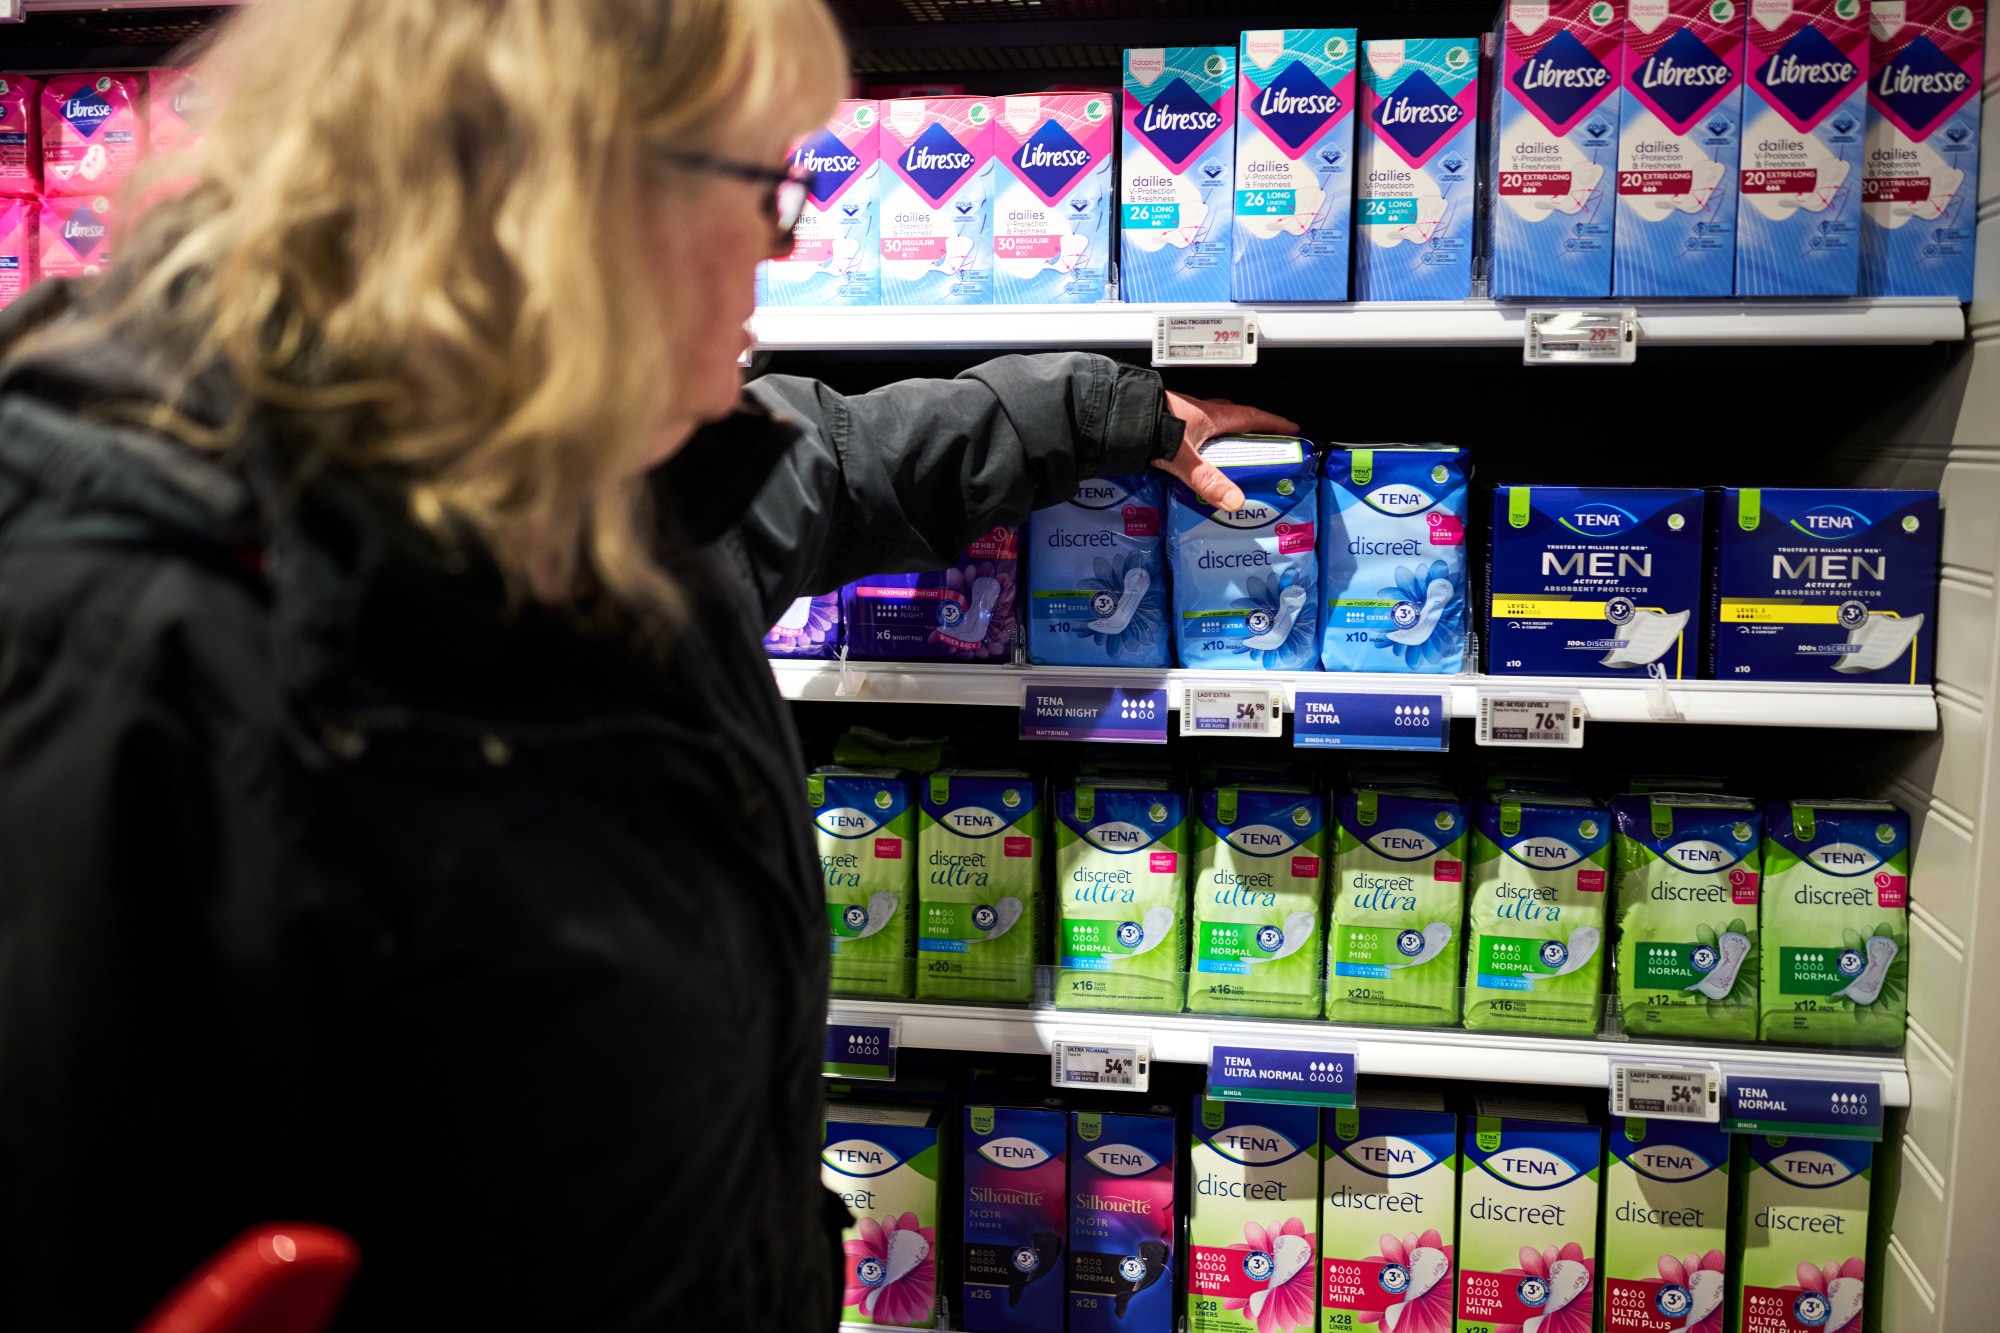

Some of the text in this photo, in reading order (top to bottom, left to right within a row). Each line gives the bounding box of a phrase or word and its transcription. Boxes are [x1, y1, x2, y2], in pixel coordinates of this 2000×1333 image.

[1523, 58, 1606, 89] Libresse
[1642, 56, 1727, 89] Libresse
[1765, 54, 1853, 86] Libresse
[1879, 65, 1967, 97] Libresse
[1260, 87, 1337, 116] Libresse
[66, 100, 110, 119] Libresse
[1381, 97, 1458, 126] Libresse
[1143, 104, 1217, 132] Libresse
[1515, 141, 1559, 154] dailies
[1758, 139, 1804, 152] dailies
[906, 147, 971, 171] Libresse
[1020, 143, 1086, 168] Libresse
[1248, 161, 1290, 172] dailies
[1369, 170, 1411, 182] dailies
[1501, 173, 1522, 188] 20
[1523, 173, 1570, 181] EXTRA LONG
[1745, 171, 1766, 186] 20
[1766, 170, 1816, 178] EXTRA LONG
[1132, 176, 1173, 187] dailies
[1128, 187, 1176, 195] V-Protection
[1137, 194, 1175, 203] Freshness
[1244, 193, 1264, 207] 26
[1130, 206, 1149, 220] 26
[1151, 206, 1174, 214] LONG
[895, 212, 930, 223] dailies
[64, 220, 104, 238] Libresse
[884, 240, 901, 252] 30
[902, 239, 935, 247] REGULAR
[1214, 331, 1229, 342] 29
[1078, 488, 1113, 498] TENA
[1378, 493, 1419, 505] TENA
[1224, 508, 1266, 520] TENA
[1574, 514, 1620, 527] TENA
[1806, 516, 1853, 529] TENA
[1048, 529, 1118, 548] discreet
[1347, 536, 1422, 556] discreet
[1198, 549, 1272, 569] discreet
[1542, 552, 1652, 578] MEN
[1772, 555, 1886, 581] MEN
[909, 590, 939, 598] COMFORT
[1049, 622, 1070, 633] x10
[876, 629, 891, 640] x6
[939, 634, 977, 648] WIDER BACK
[1346, 632, 1368, 643] x10
[1036, 696, 1064, 706] TENA
[1305, 702, 1335, 713] TENA
[1036, 707, 1098, 718] MAXI NIGHT
[1236, 703, 1265, 719] 54 98
[1305, 713, 1341, 725] EXTRA
[1535, 713, 1565, 730] 76 98
[828, 815, 865, 828] TENA
[953, 814, 993, 827] TENA
[1098, 830, 1139, 842] TENA
[1240, 833, 1281, 846] TENA
[1381, 836, 1423, 850] TENA
[929, 850, 986, 867] discreet
[1524, 845, 1566, 859] TENA
[1677, 849, 1720, 862] TENA
[1820, 852, 1864, 864] TENA
[1073, 866, 1132, 884] discreet
[1213, 869, 1274, 888] discreet
[1353, 873, 1414, 892] discreet
[1075, 879, 1135, 904] ultra
[1215, 882, 1276, 907] ultra
[1495, 882, 1558, 902] discreet
[1651, 881, 1728, 903] discreet
[1794, 884, 1873, 906] discreet
[1354, 885, 1417, 912] ultra
[928, 926, 949, 934] MINI
[1072, 944, 1112, 953] NORMAL
[1349, 950, 1372, 959] MINI
[928, 962, 949, 973] x20
[1491, 962, 1535, 972] NORMAL
[1648, 967, 1692, 977] NORMAL
[1794, 972, 1840, 982] NORMAL
[1072, 980, 1093, 991] x16
[1490, 1000, 1512, 1012] x16
[1647, 995, 1669, 1006] x12
[1104, 1058, 1123, 1074] 54
[1224, 1056, 1252, 1067] TENA
[1224, 1068, 1304, 1081] ULTRA NORMAL
[1671, 1085, 1701, 1102] 54 98
[1738, 1087, 1768, 1099] TENA
[1738, 1099, 1787, 1111] NORMAL
[1226, 1135, 1278, 1152] TENA
[835, 1149, 882, 1165] TENA
[991, 1145, 1035, 1159] TENA
[1360, 1146, 1415, 1164] TENA
[1099, 1152, 1143, 1166] TENA
[1643, 1154, 1693, 1170] TENA
[1502, 1158, 1558, 1176] TENA
[1784, 1159, 1835, 1176] TENA
[1197, 1172, 1287, 1202] discreet
[969, 1186, 1044, 1206] Silhouette
[1331, 1184, 1424, 1214] discreet
[1076, 1193, 1152, 1215] Silhouette
[1469, 1196, 1566, 1227] discreet
[1615, 1200, 1705, 1229] discreet
[969, 1221, 1002, 1229] LINERS
[1076, 1216, 1108, 1227] NOIR
[1754, 1206, 1846, 1236] discreet
[1076, 1273, 1115, 1284] NORMAL
[1195, 1272, 1230, 1283] ULTRA
[1195, 1280, 1220, 1290] MINI
[1076, 1298, 1098, 1309] x26
[1195, 1301, 1217, 1311] x28
[1611, 1308, 1650, 1320] ULTRA
[1611, 1316, 1671, 1330] MINI PLUS
[1748, 1316, 1787, 1328] ULTRA
